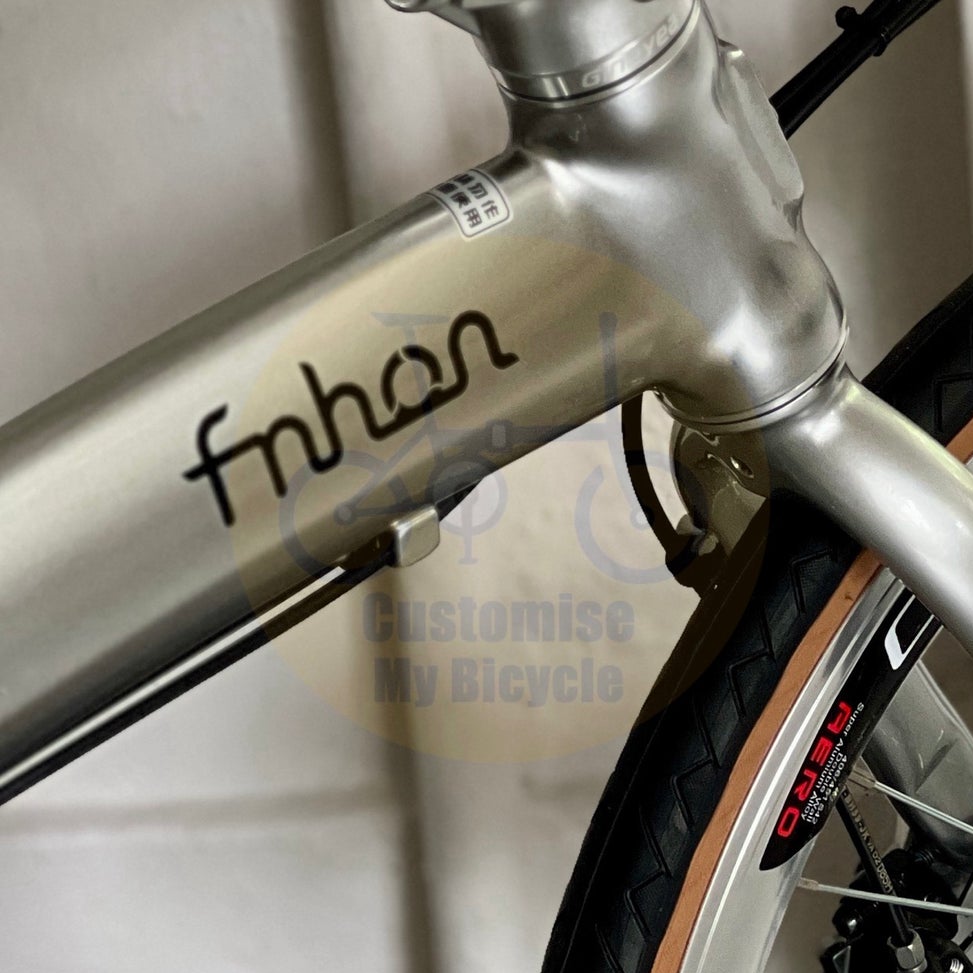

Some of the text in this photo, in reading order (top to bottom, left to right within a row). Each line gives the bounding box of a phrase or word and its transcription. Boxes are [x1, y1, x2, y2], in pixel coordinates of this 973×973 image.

[842, 702, 865, 737] Super
[777, 701, 852, 837] AERO
[806, 752, 844, 823] Double Wall
[801, 790, 818, 821] Alloy
